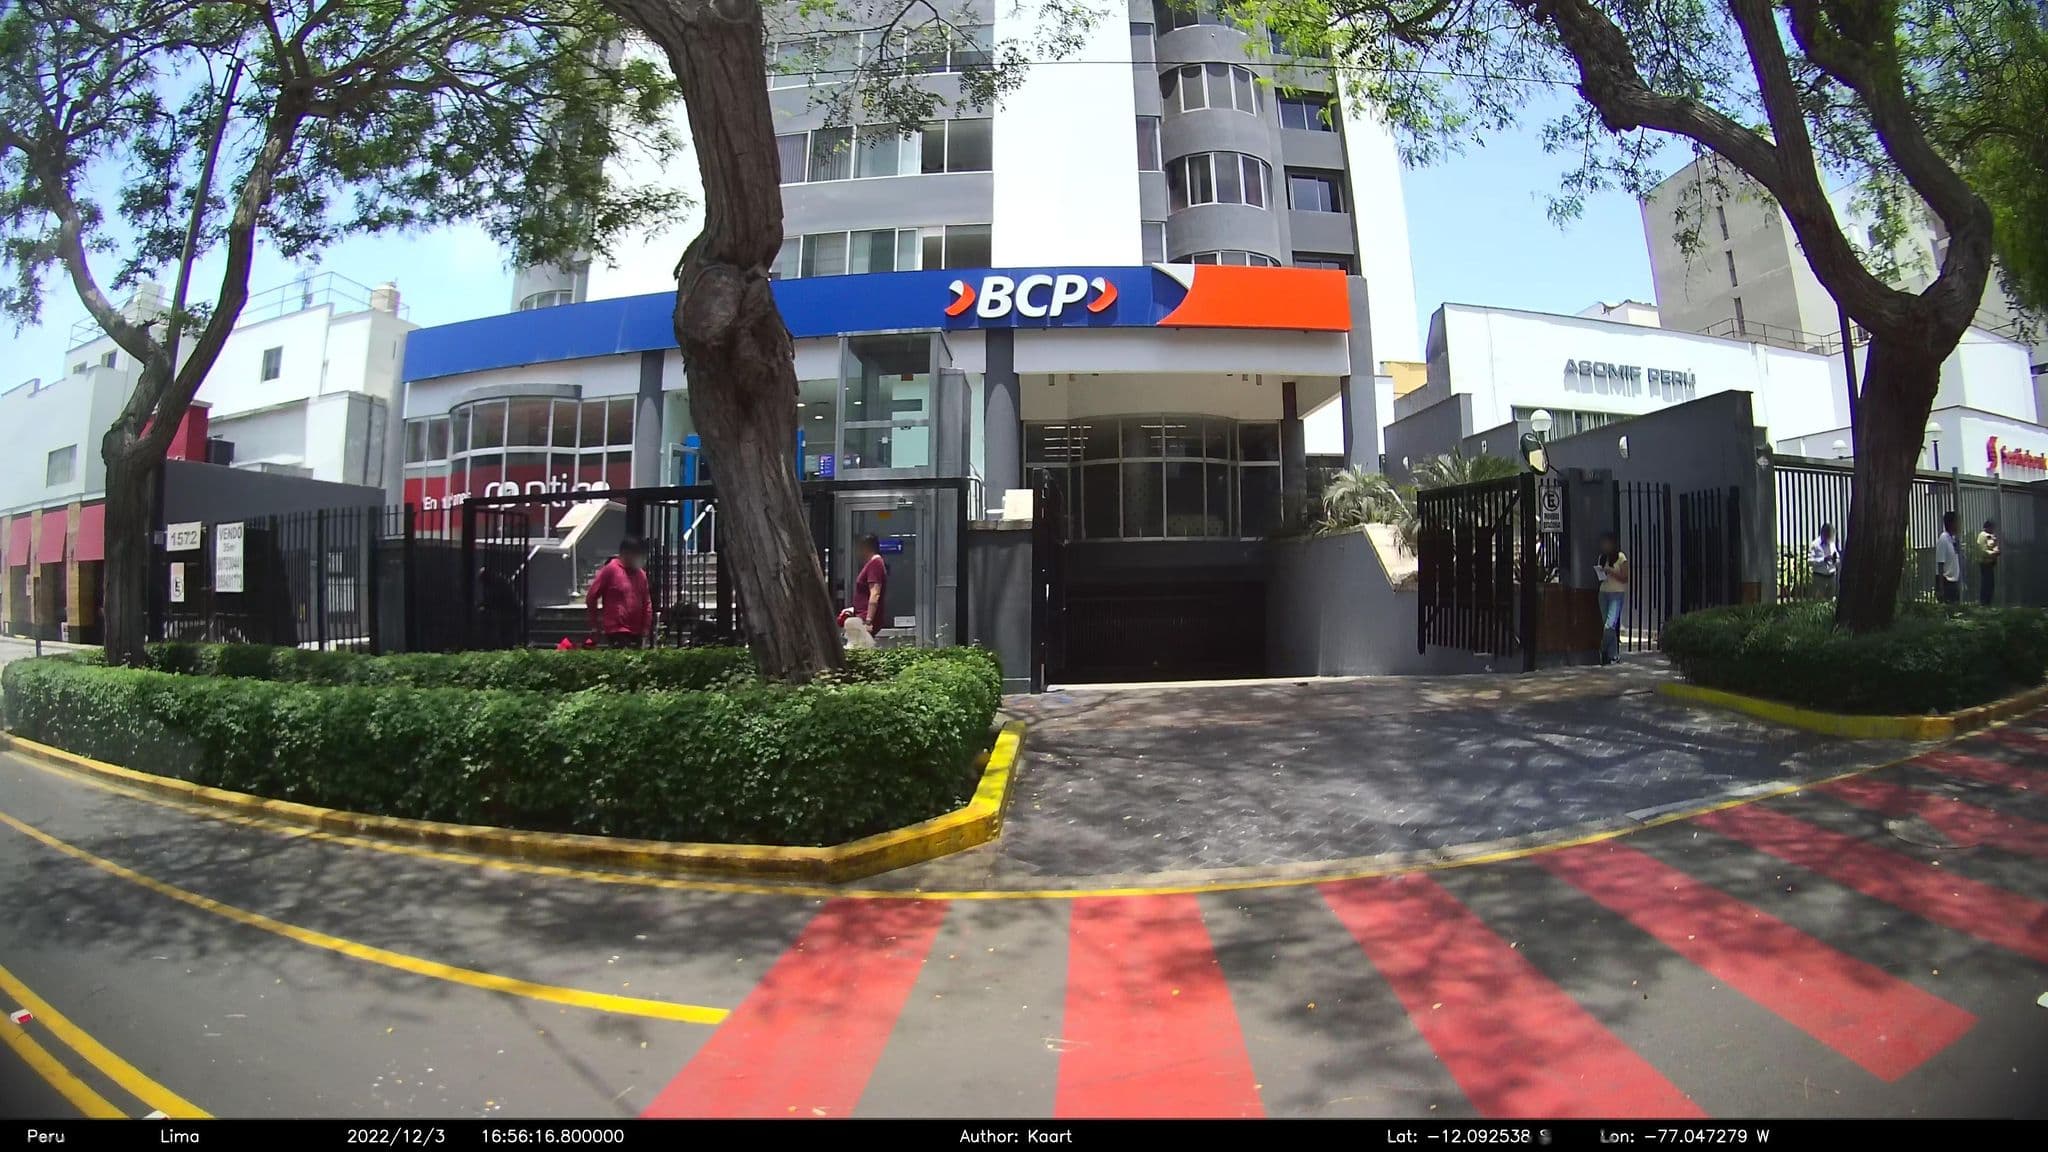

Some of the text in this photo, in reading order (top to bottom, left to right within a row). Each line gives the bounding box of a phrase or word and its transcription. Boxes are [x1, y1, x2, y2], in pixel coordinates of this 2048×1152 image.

[977, 274, 1089, 318] BCP
[1564, 358, 1642, 382] ASOMIF
[171, 530, 198, 546] 1572
[219, 526, 243, 541] VENDO
